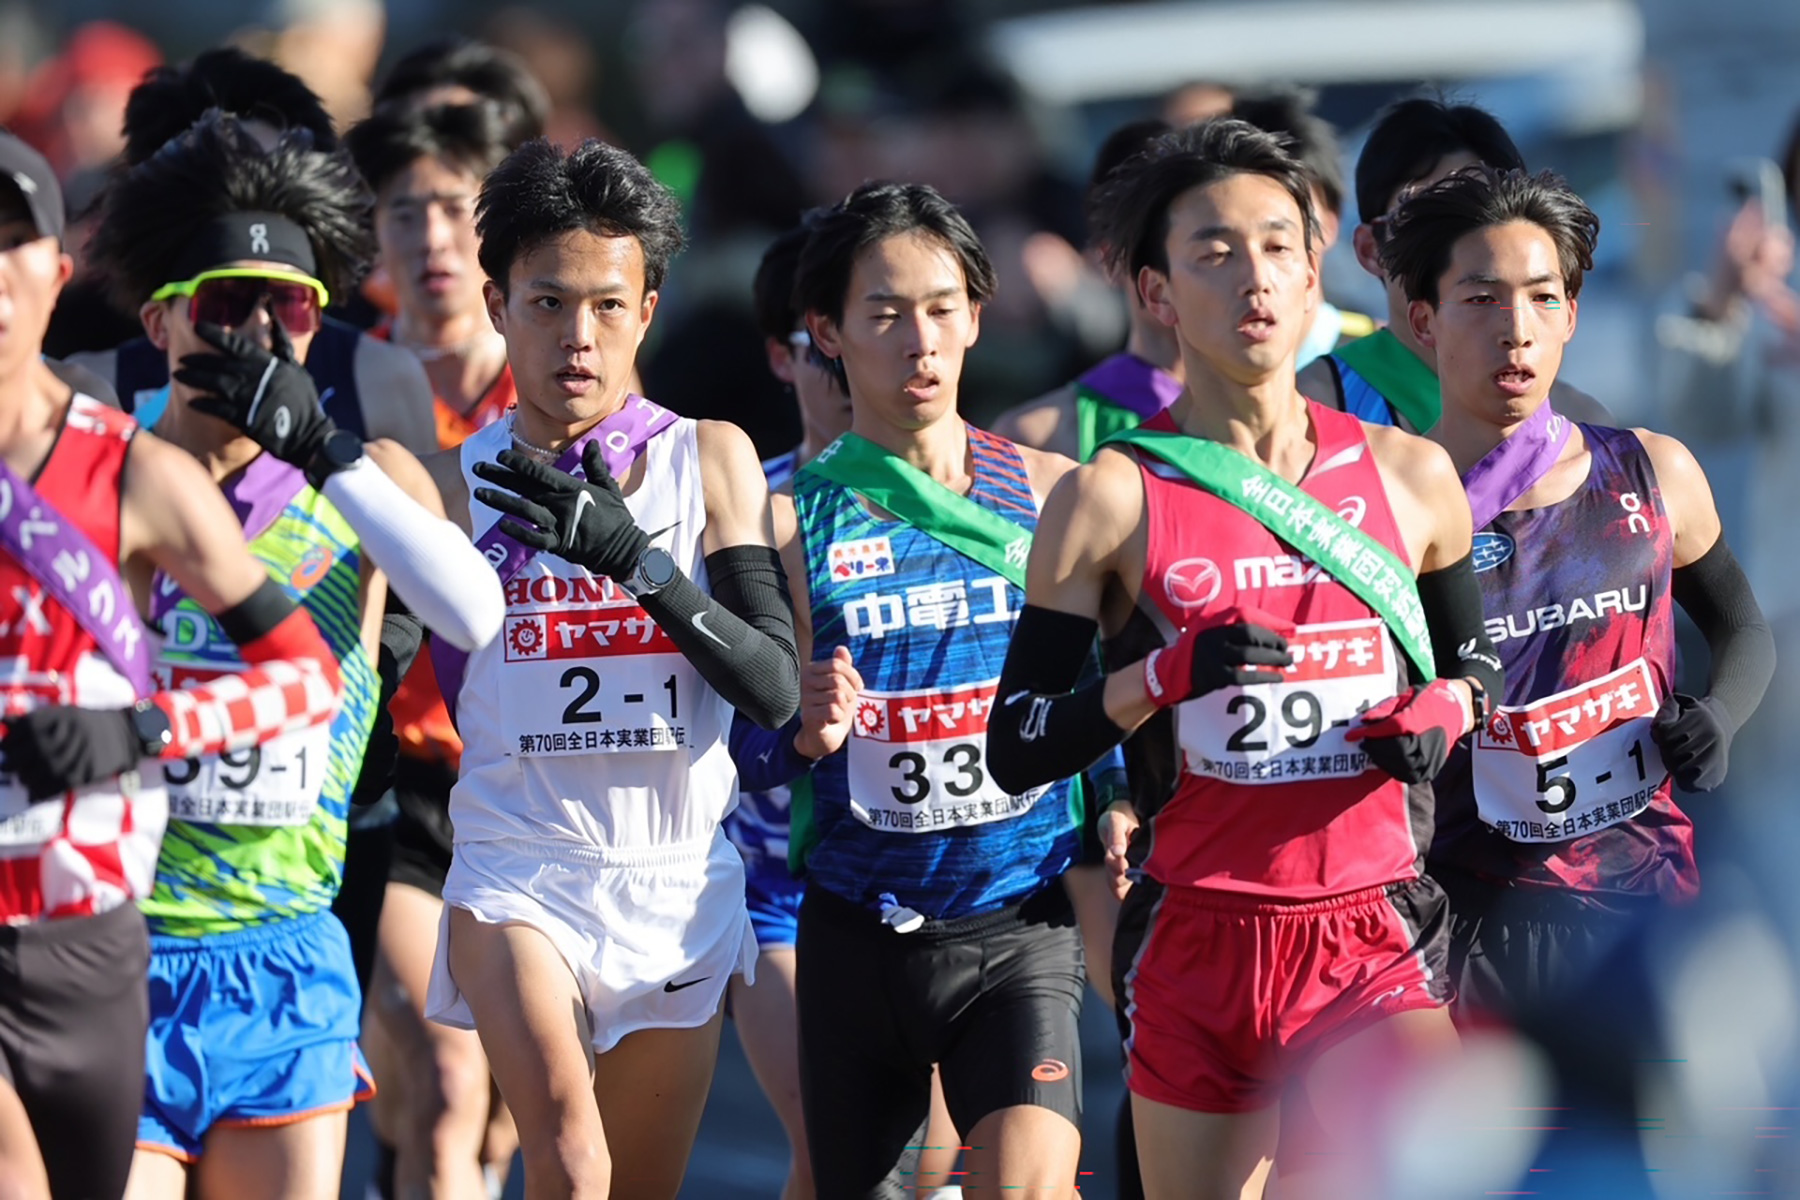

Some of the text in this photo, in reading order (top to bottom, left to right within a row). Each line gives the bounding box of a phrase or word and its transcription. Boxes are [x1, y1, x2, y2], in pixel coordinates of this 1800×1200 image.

[504, 577, 615, 606] HON
[1233, 554, 1336, 591] maz
[843, 576, 1022, 639] 中電工
[1483, 584, 1647, 645] SUBARU
[1246, 636, 1378, 673] マザキ
[559, 666, 678, 724] 2-1
[1520, 682, 1642, 748] ヤマザキ
[888, 743, 984, 805] 33
[1202, 752, 1372, 780] 第70回全日本実業団駅
[1535, 738, 1647, 814] 5-1
